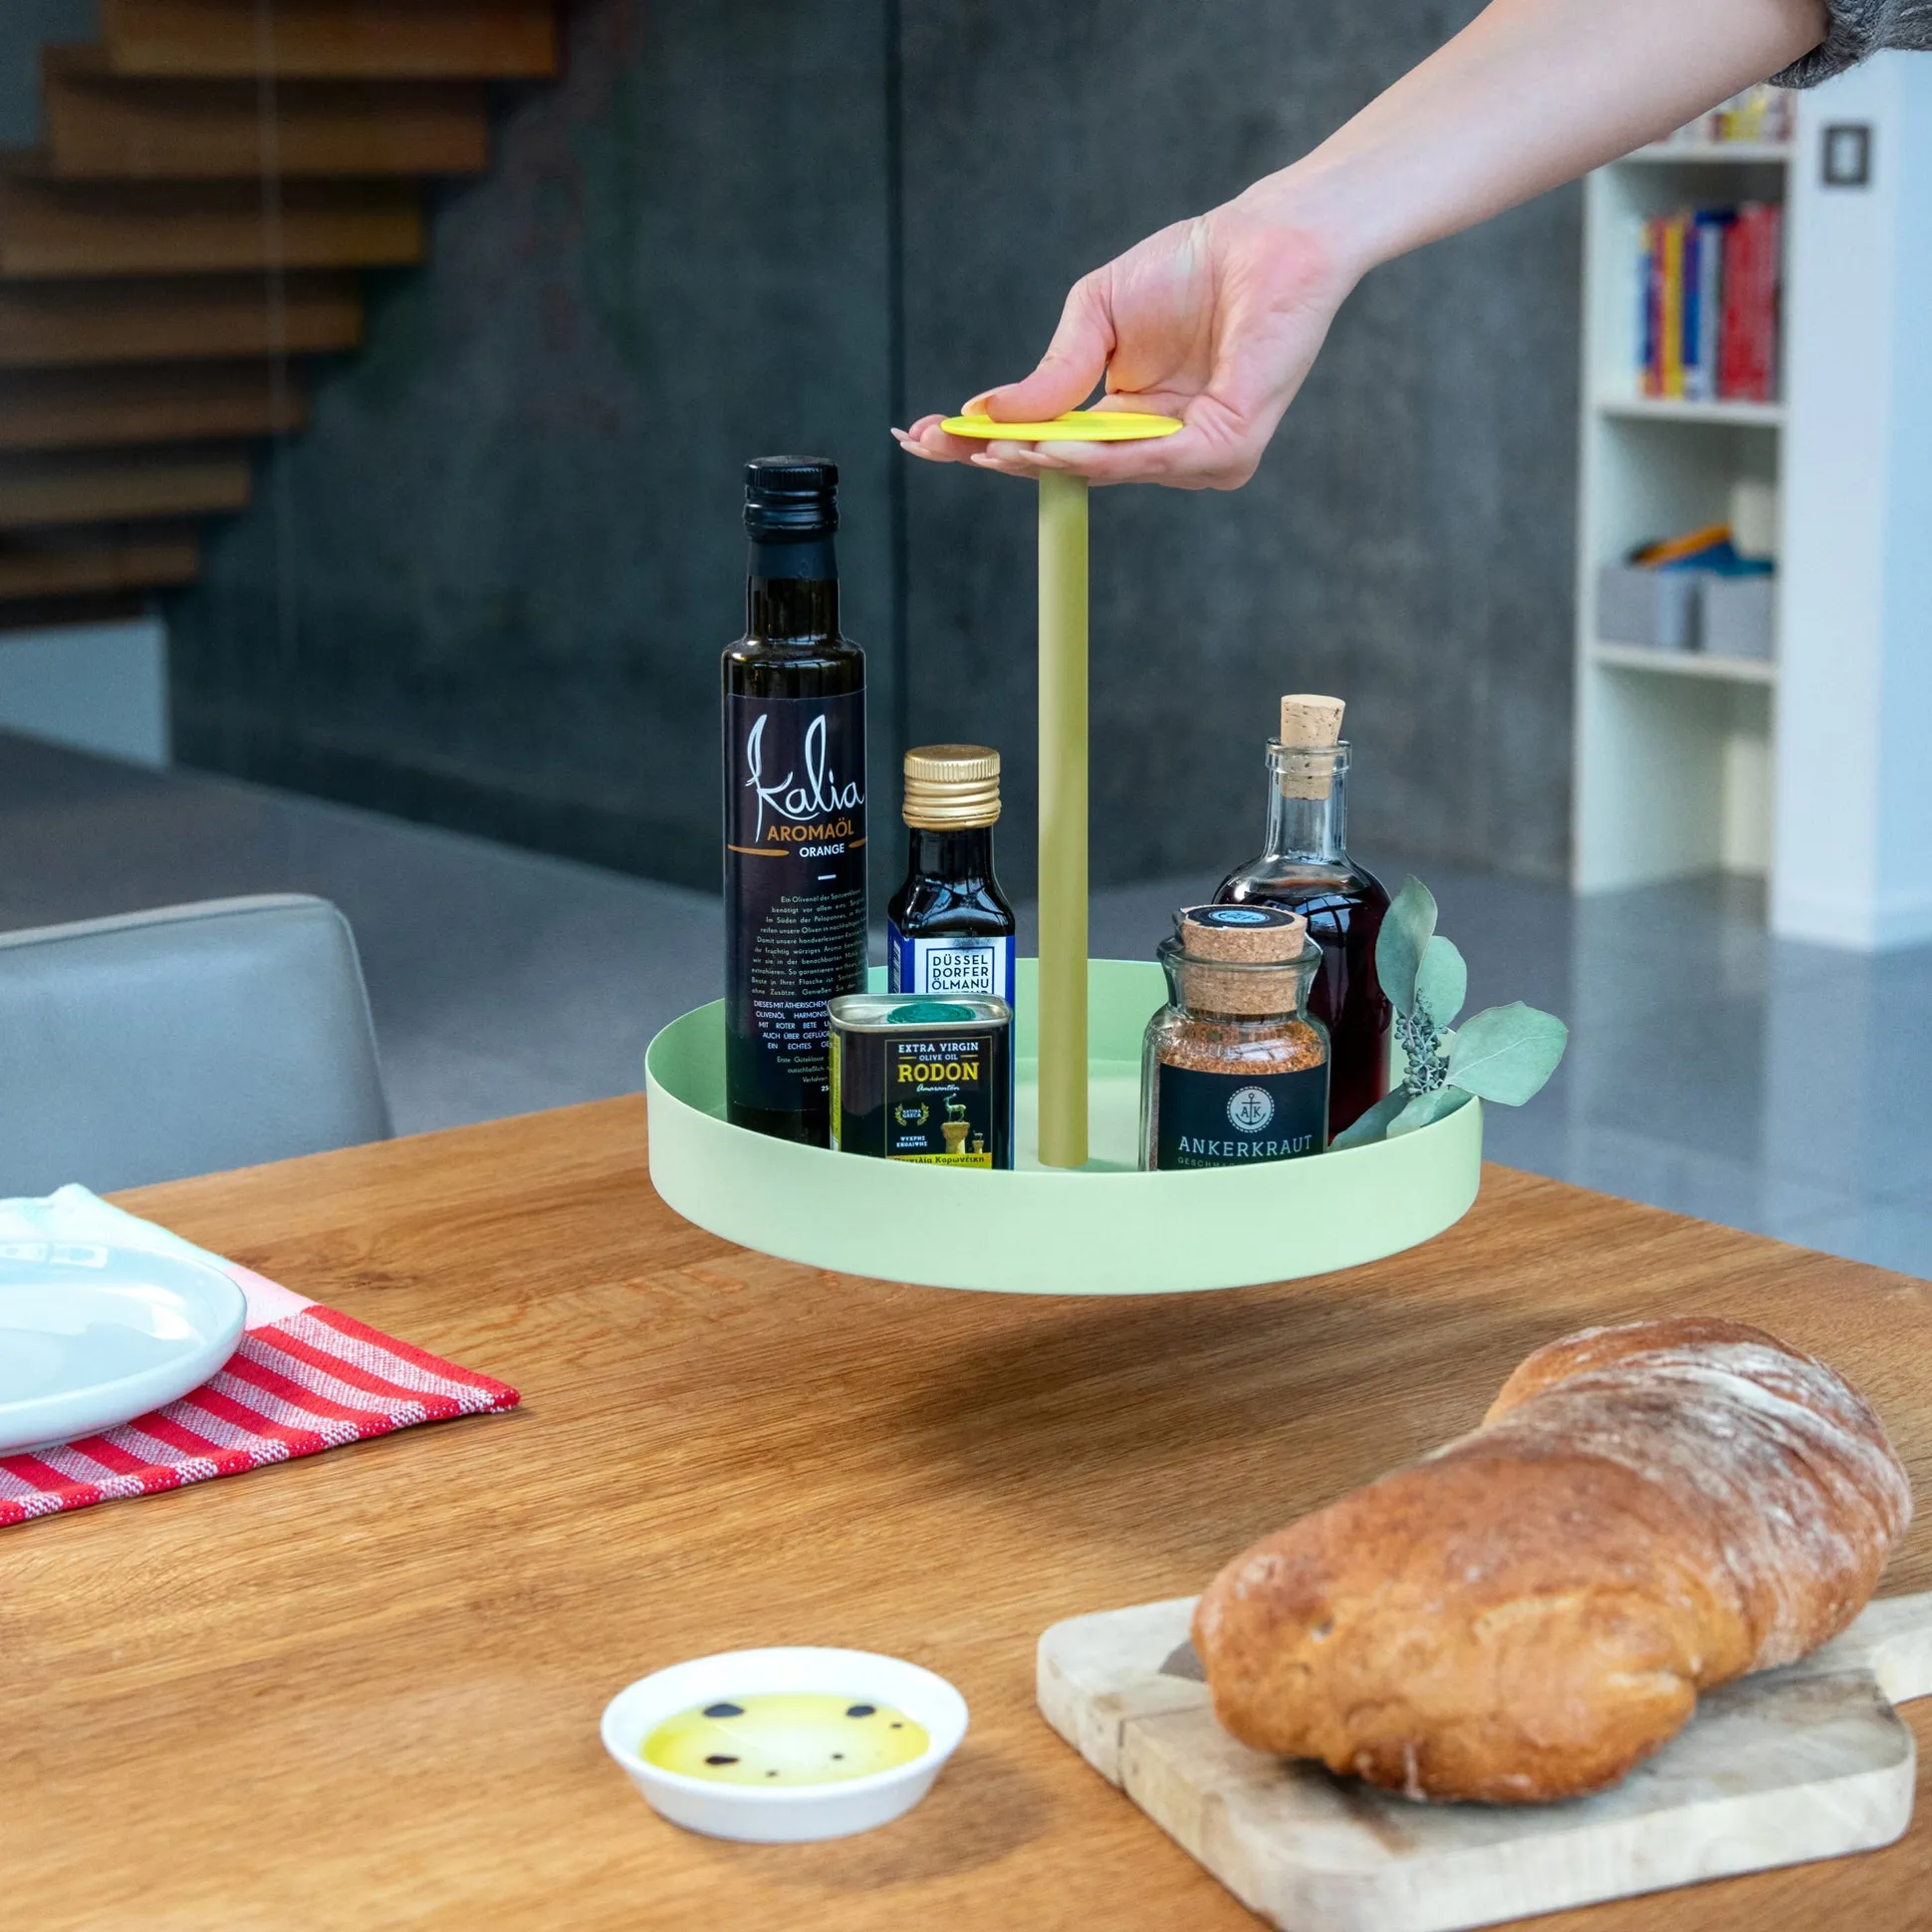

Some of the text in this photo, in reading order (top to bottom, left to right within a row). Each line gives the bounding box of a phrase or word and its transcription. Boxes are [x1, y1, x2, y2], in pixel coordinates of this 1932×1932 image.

[745, 714, 864, 844] Kalia
[767, 817, 854, 842] AROMAÖL
[799, 843, 845, 857] ORANGE
[802, 955, 843, 964] benachbarten
[932, 953, 988, 966] DÜSSEL
[798, 967, 835, 976] garantieren
[932, 966, 989, 977] DORFER
[751, 976, 767, 985] Beste
[931, 977, 989, 990] ÖLMANU
[802, 987, 833, 996] Genießen
[753, 1000, 774, 1009] DIESES
[785, 1000, 828, 1009] ÄTHERISCHEM
[755, 1010, 786, 1019] OLIVENÖL
[897, 1042, 979, 1054] EXTRA VIRGIN
[897, 1062, 980, 1083] RODON
[1177, 1134, 1314, 1157] ANKERKRAUT
